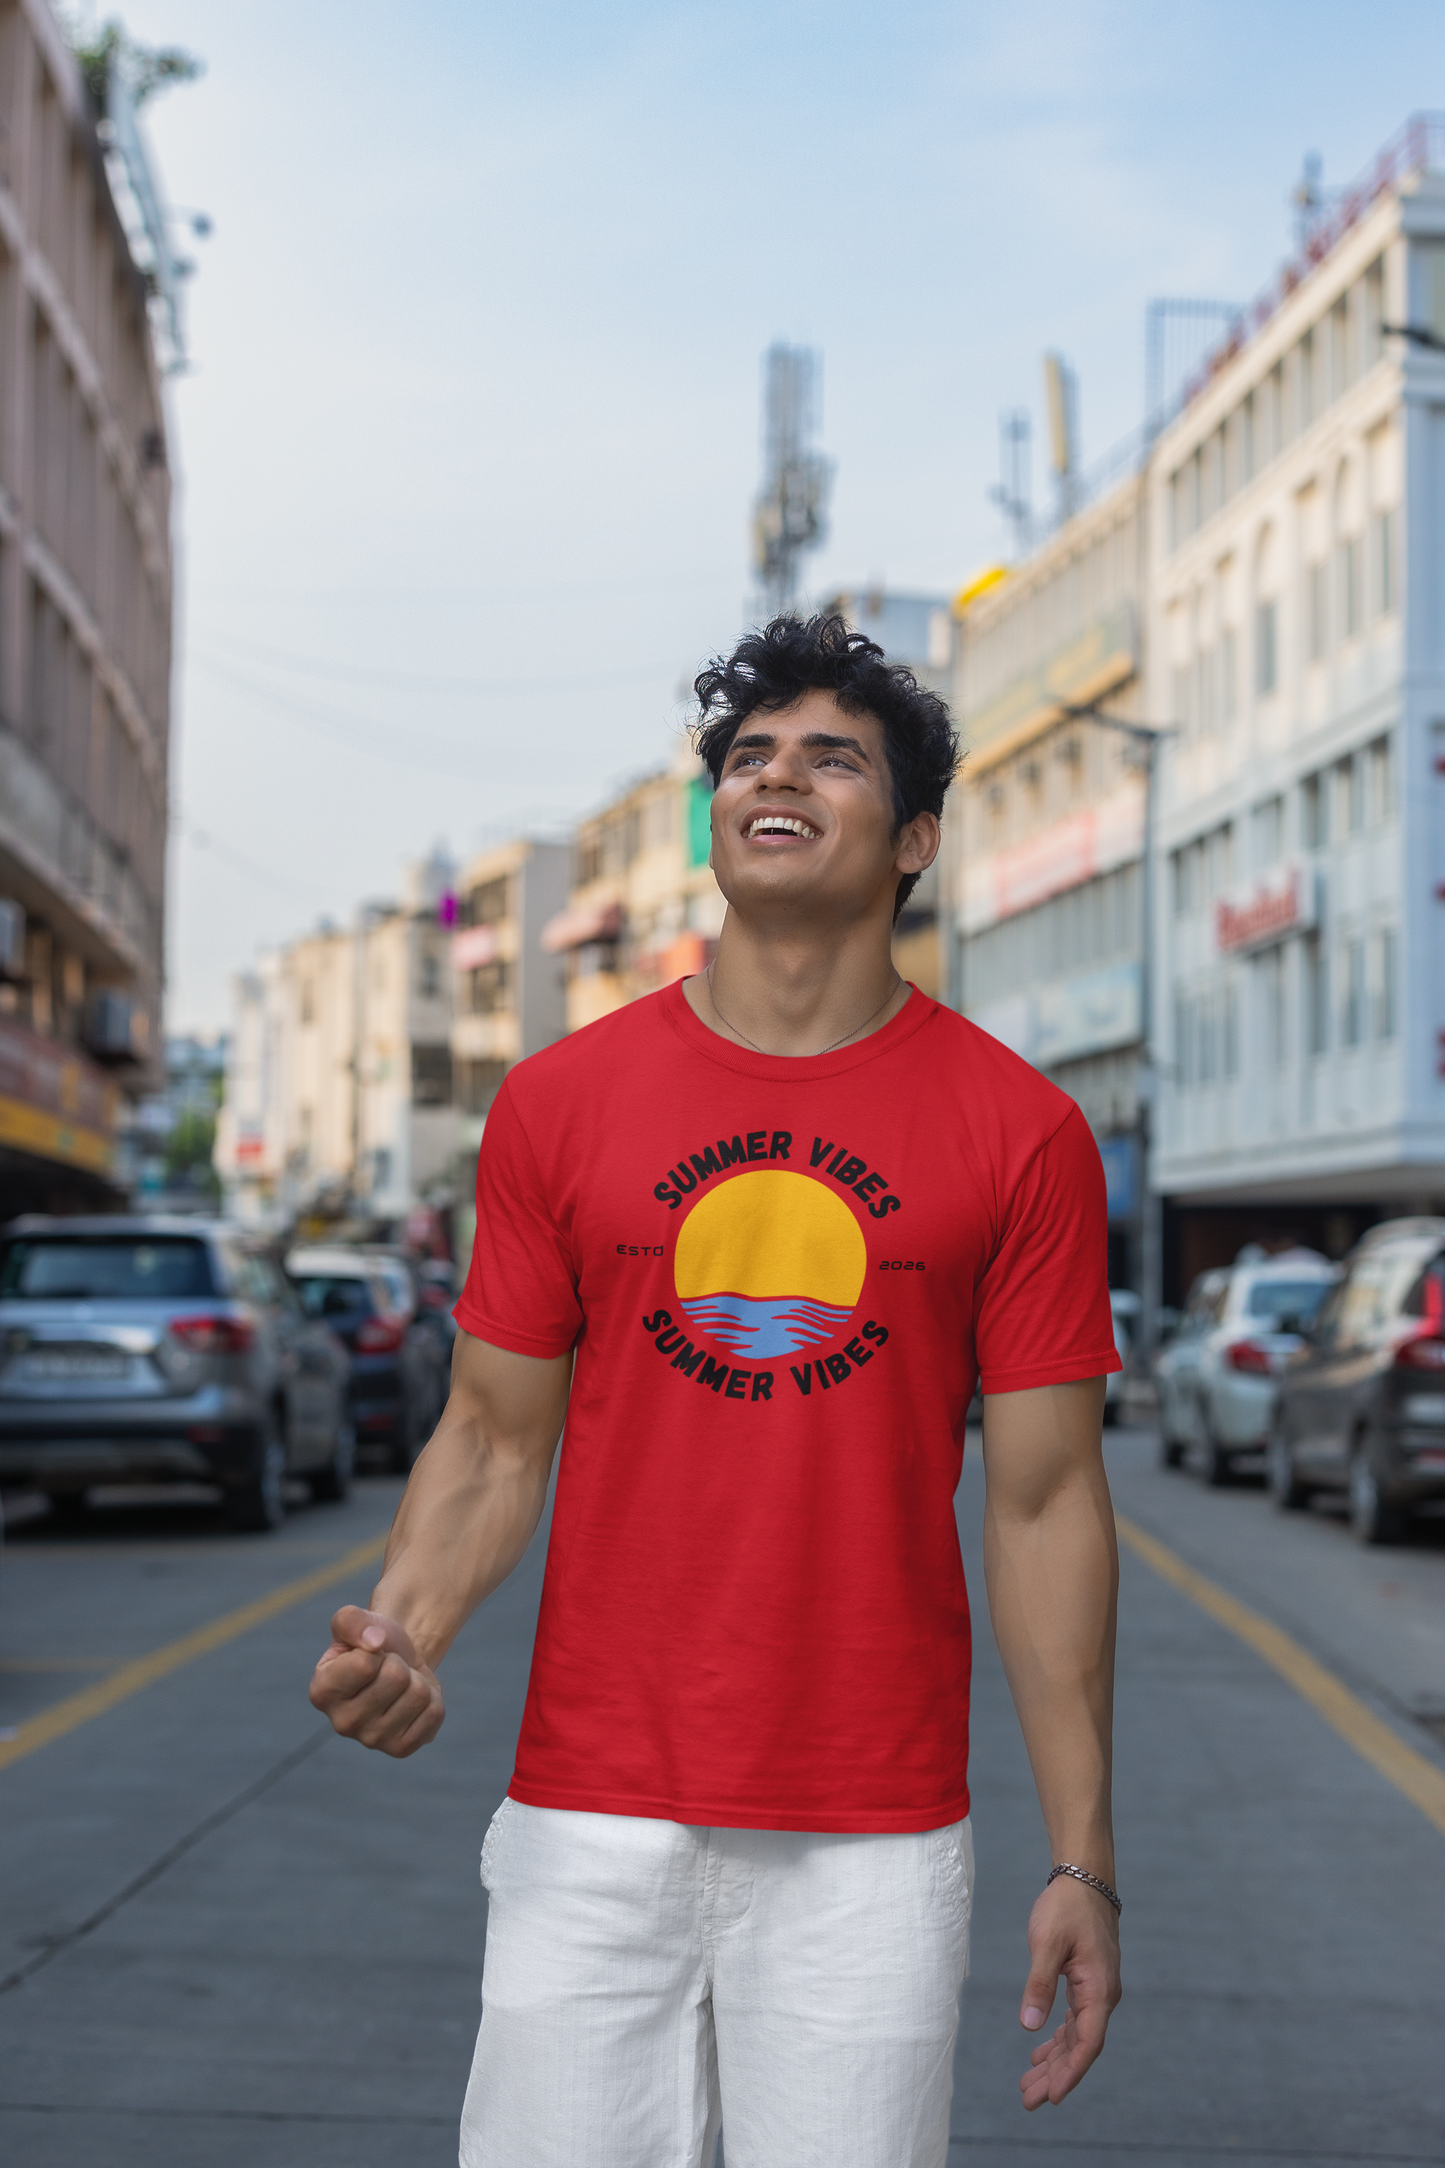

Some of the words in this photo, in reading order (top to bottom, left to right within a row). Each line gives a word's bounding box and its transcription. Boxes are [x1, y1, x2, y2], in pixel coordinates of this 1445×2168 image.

[653, 1130, 793, 1210] SUMMER
[809, 1136, 901, 1219] VIBES
[878, 1260, 926, 1271] 2026
[642, 1309, 774, 1402] SUMMER
[789, 1320, 889, 1396] VIBES
